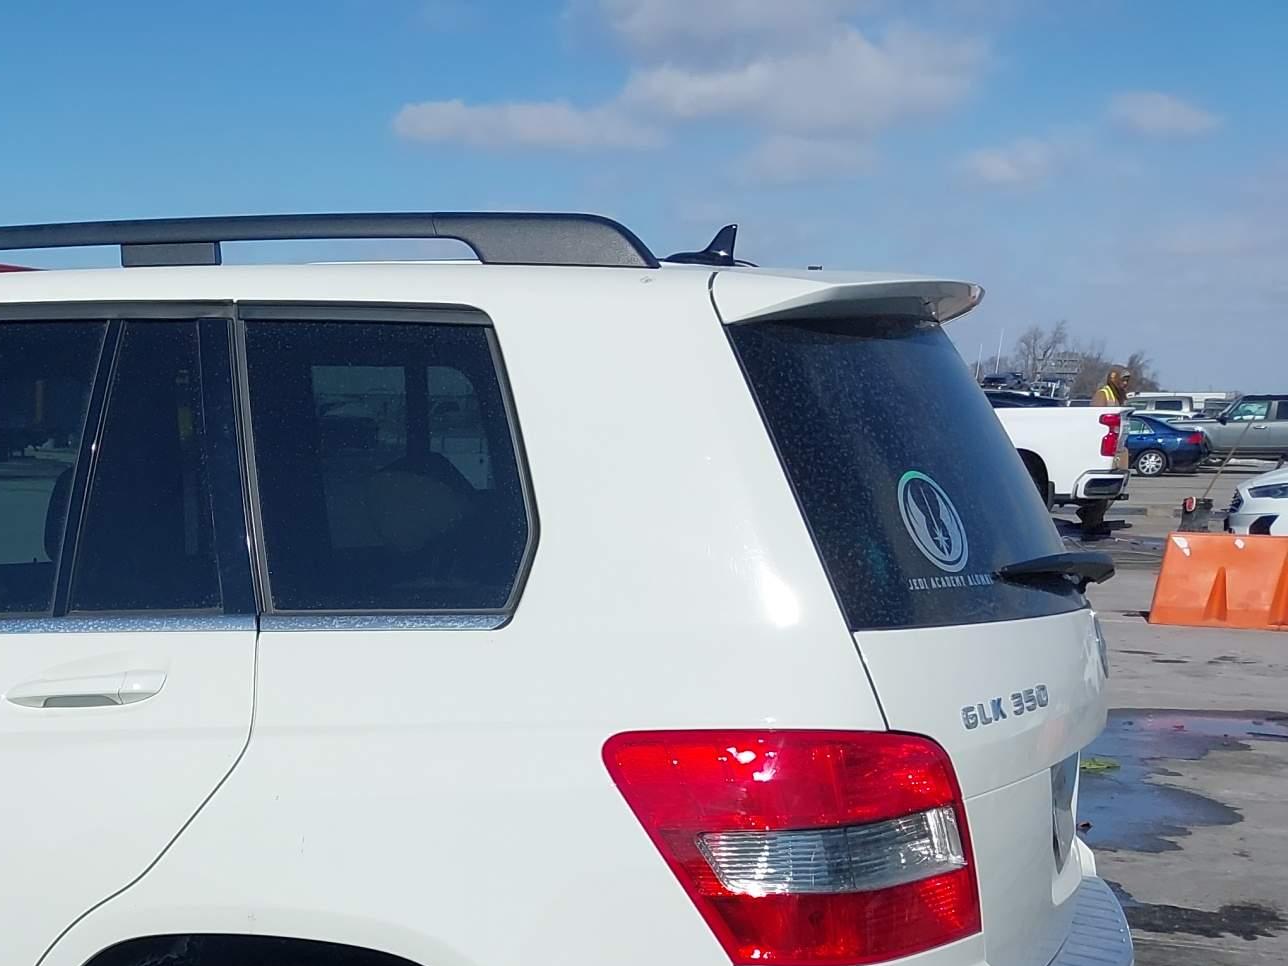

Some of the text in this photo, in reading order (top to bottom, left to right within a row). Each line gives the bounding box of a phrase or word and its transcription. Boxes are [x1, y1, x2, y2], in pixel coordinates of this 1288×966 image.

[908, 577, 929, 591] JEDI
[930, 575, 967, 589] ACADEMY
[961, 684, 1049, 730] GLK 350
